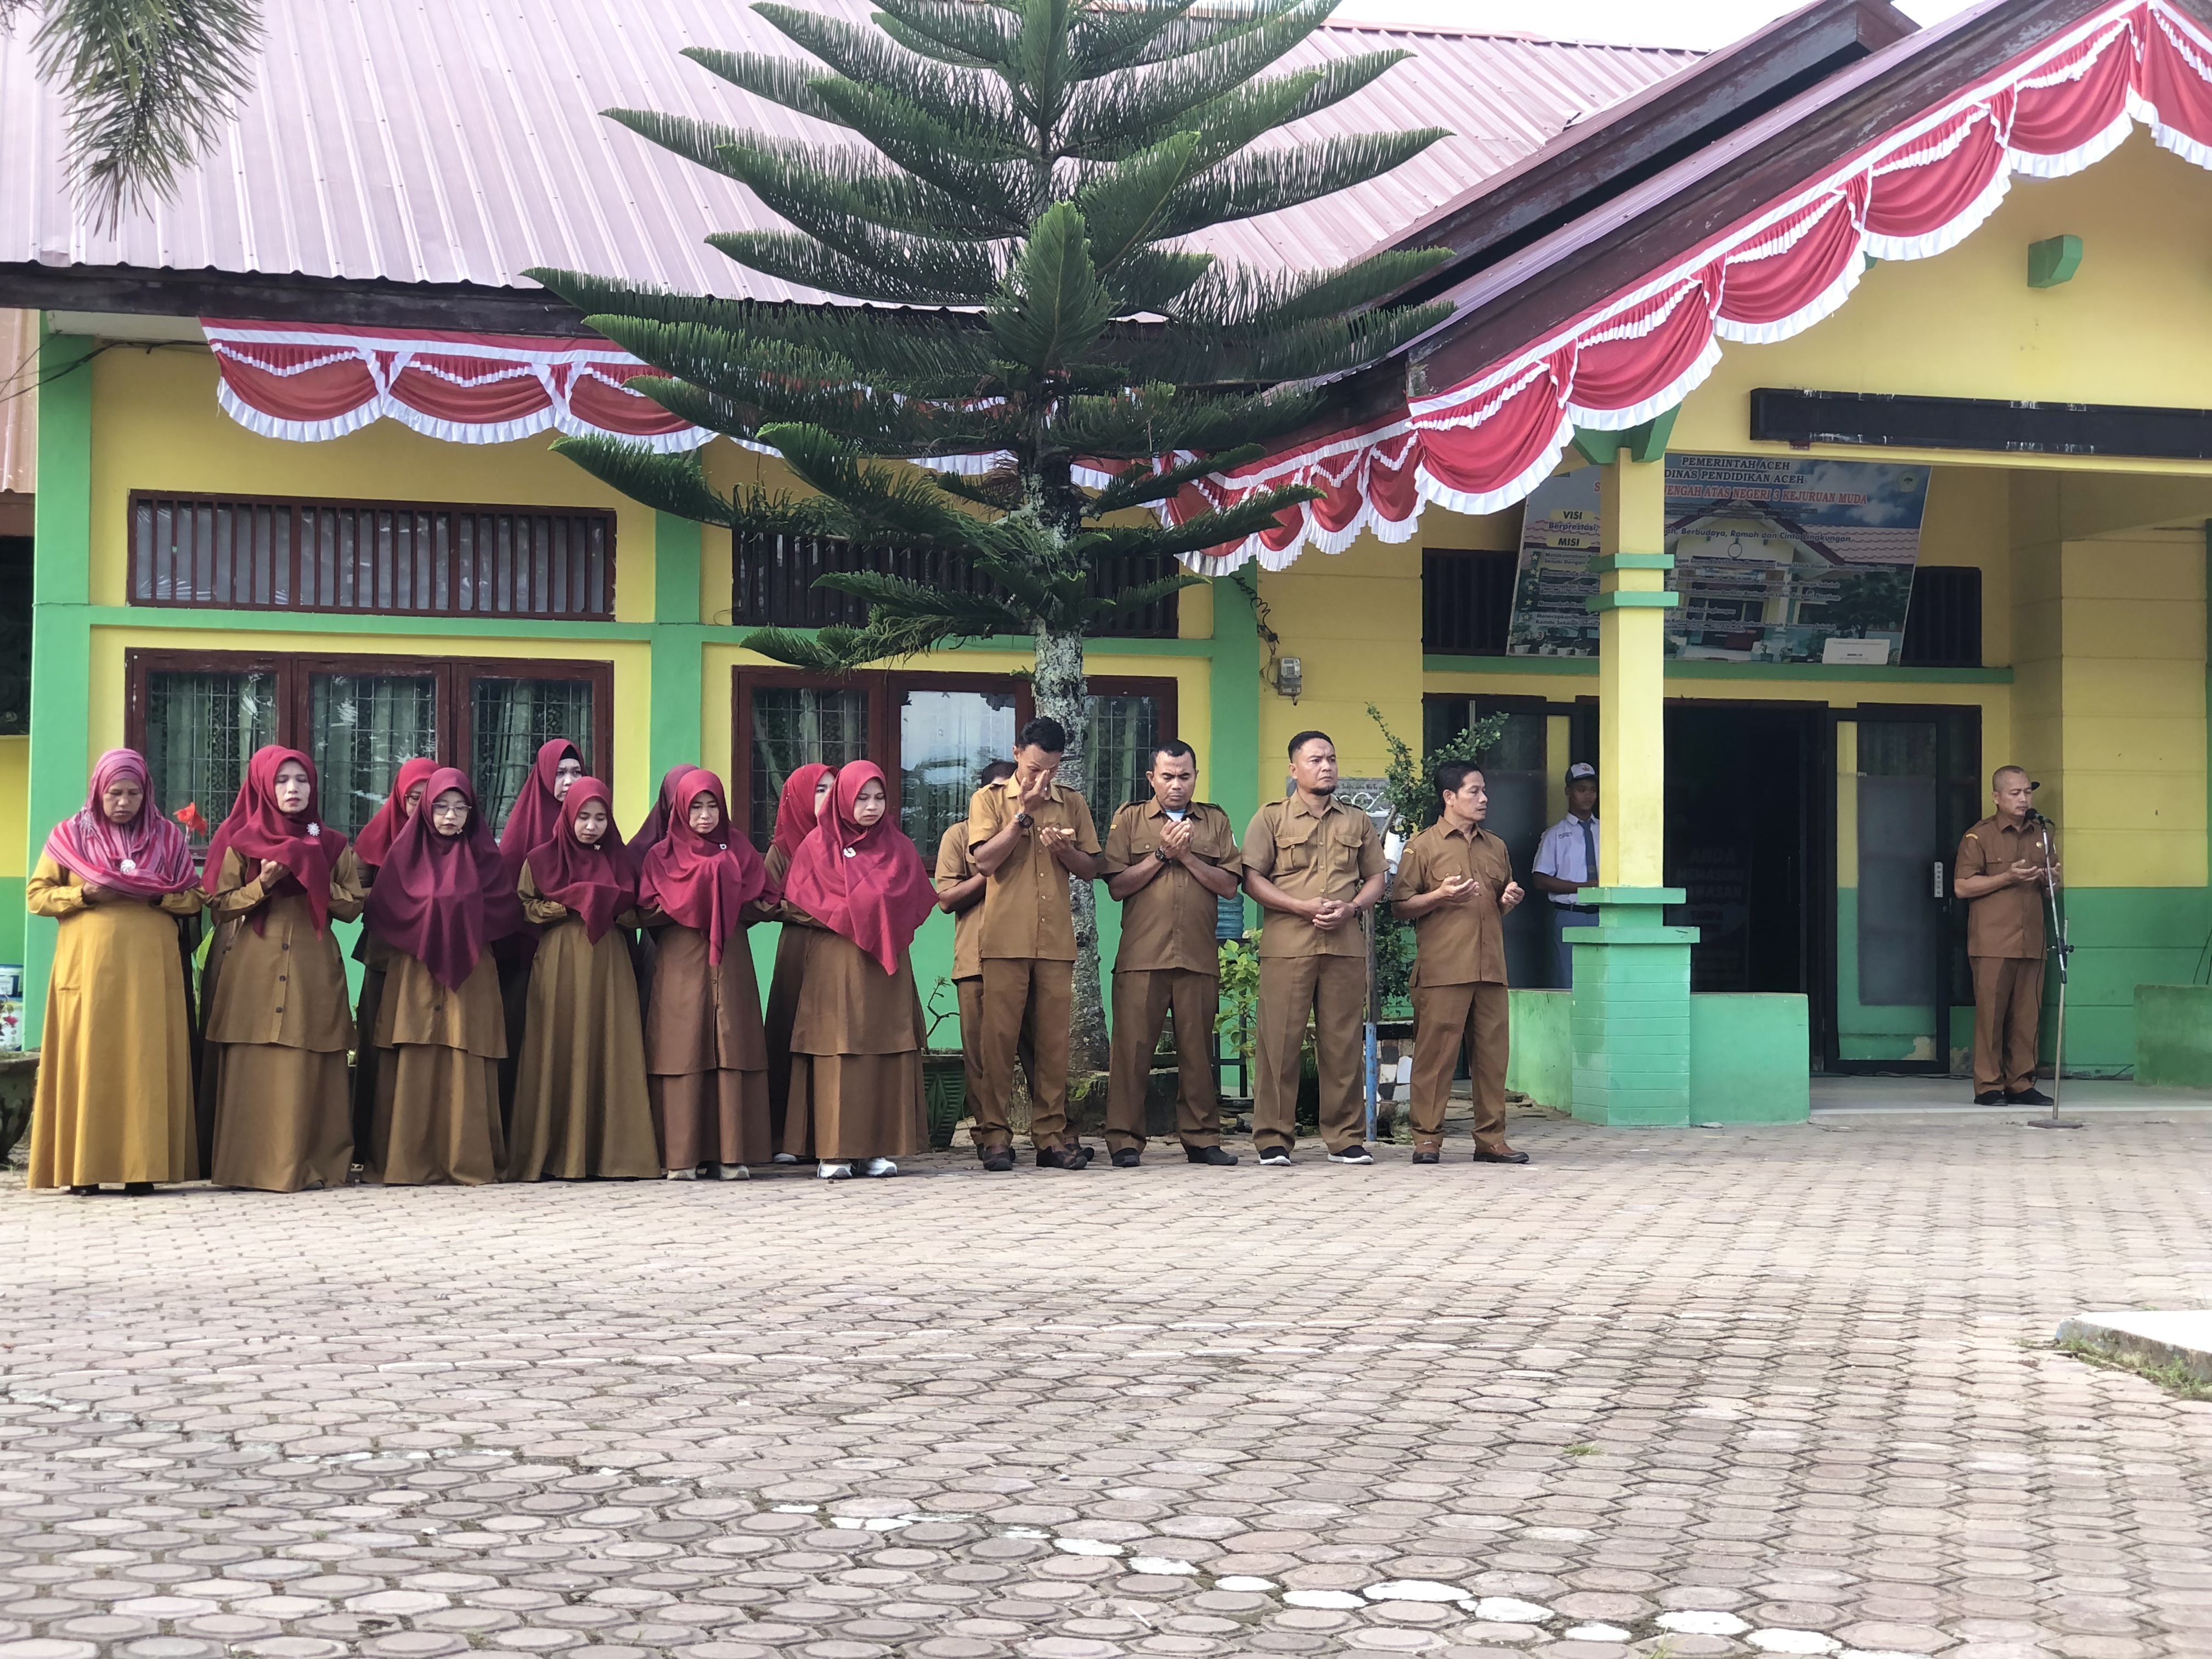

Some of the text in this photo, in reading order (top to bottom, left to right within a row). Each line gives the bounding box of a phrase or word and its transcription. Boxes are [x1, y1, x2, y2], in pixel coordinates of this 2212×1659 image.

[1681, 456, 1790, 470] PEMERINTAH ACEH
[1664, 469, 1805, 484] DINAS PENDIDIKAN ACEH
[1705, 486, 1730, 498] ATAS
[1733, 487, 1771, 500] NEGERI
[1773, 490, 1779, 500] 3
[1782, 490, 1836, 503] KEJURUAN
[1838, 493, 1867, 504] MUDA
[1563, 511, 1583, 520] VISI
[1549, 522, 1598, 532] Berprestasi,
[1681, 528, 1728, 538] Berbudaya,
[1730, 530, 1759, 538] Ramah
[1802, 533, 1850, 544] Lingkungan
[1558, 538, 1580, 546] MISI
